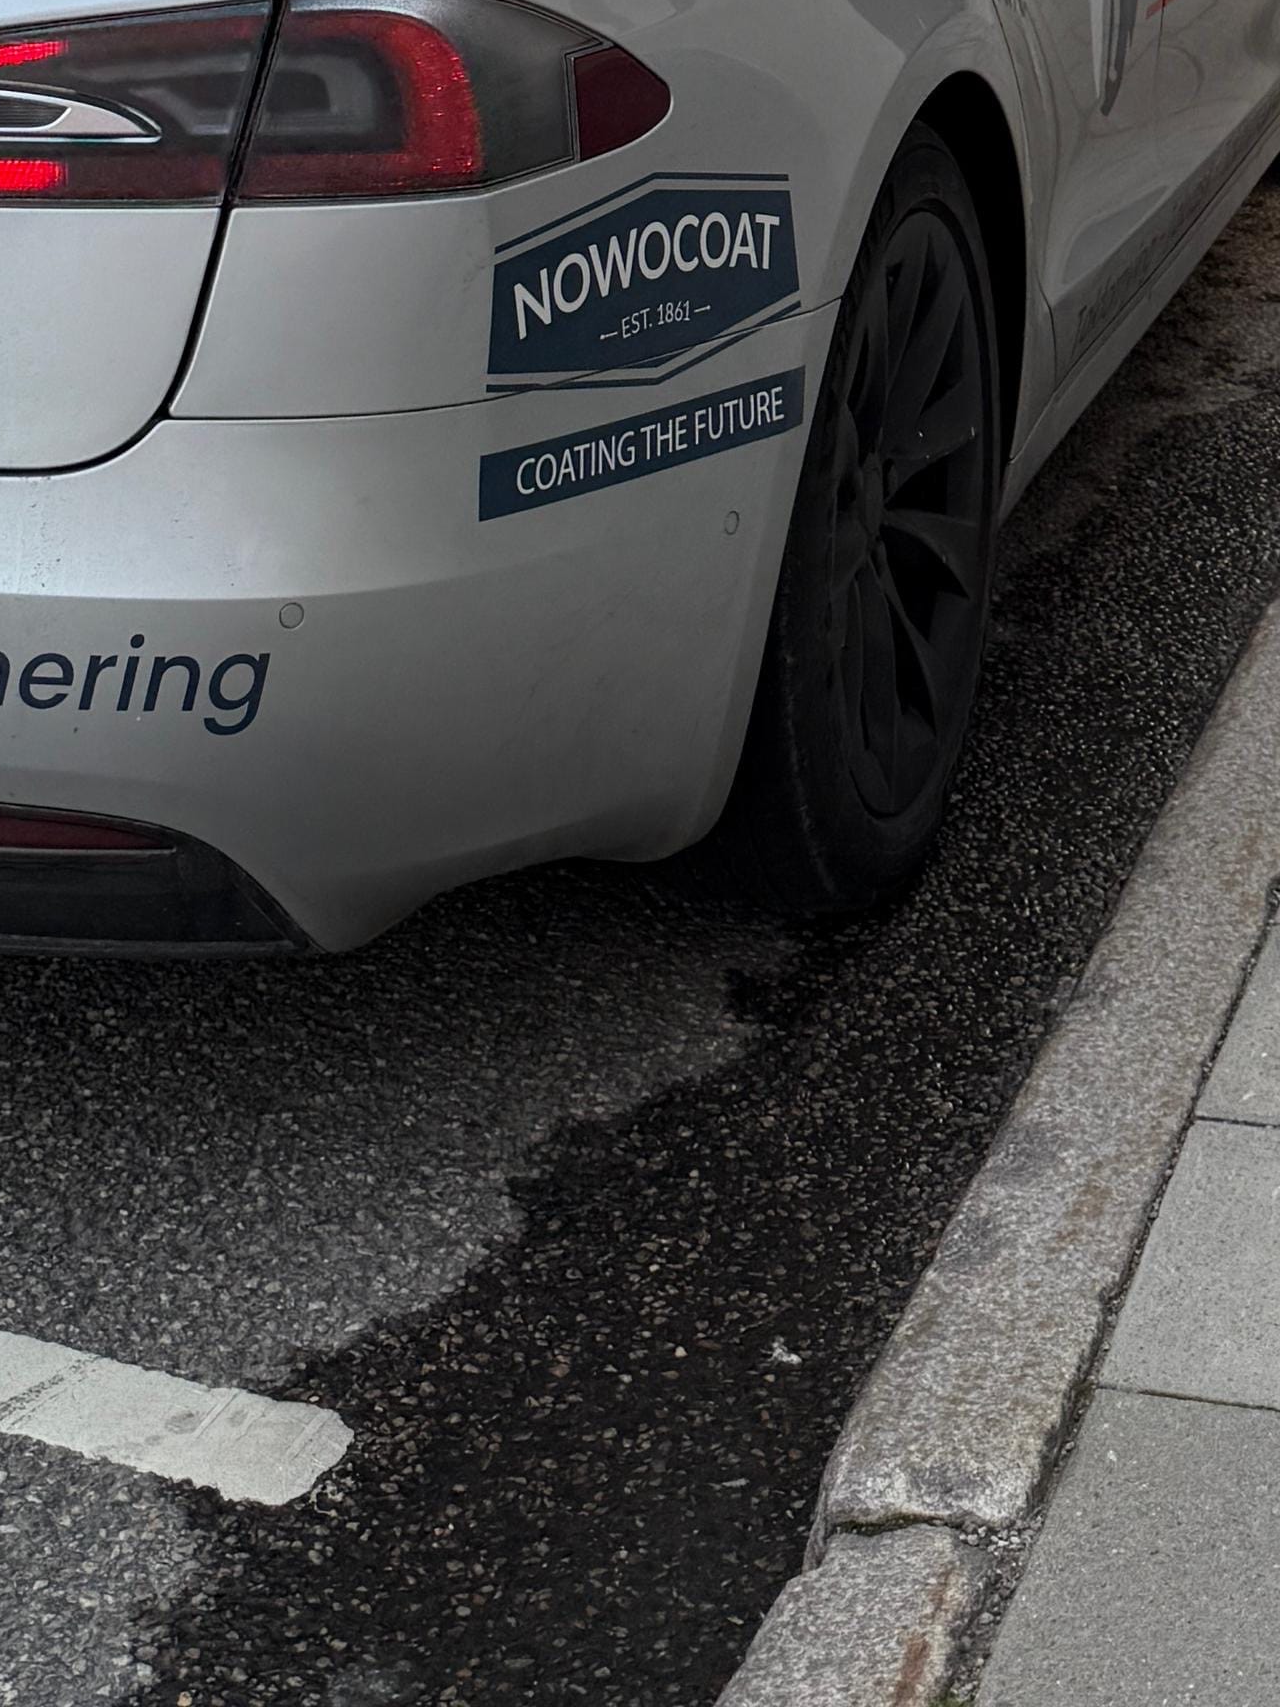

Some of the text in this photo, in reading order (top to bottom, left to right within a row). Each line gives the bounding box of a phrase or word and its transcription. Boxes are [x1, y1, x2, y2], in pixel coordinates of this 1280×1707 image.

[513, 211, 781, 340] NOWOCOAT
[621, 300, 692, 340] EST. 1861
[515, 386, 785, 496] COATING THE FUTURE
